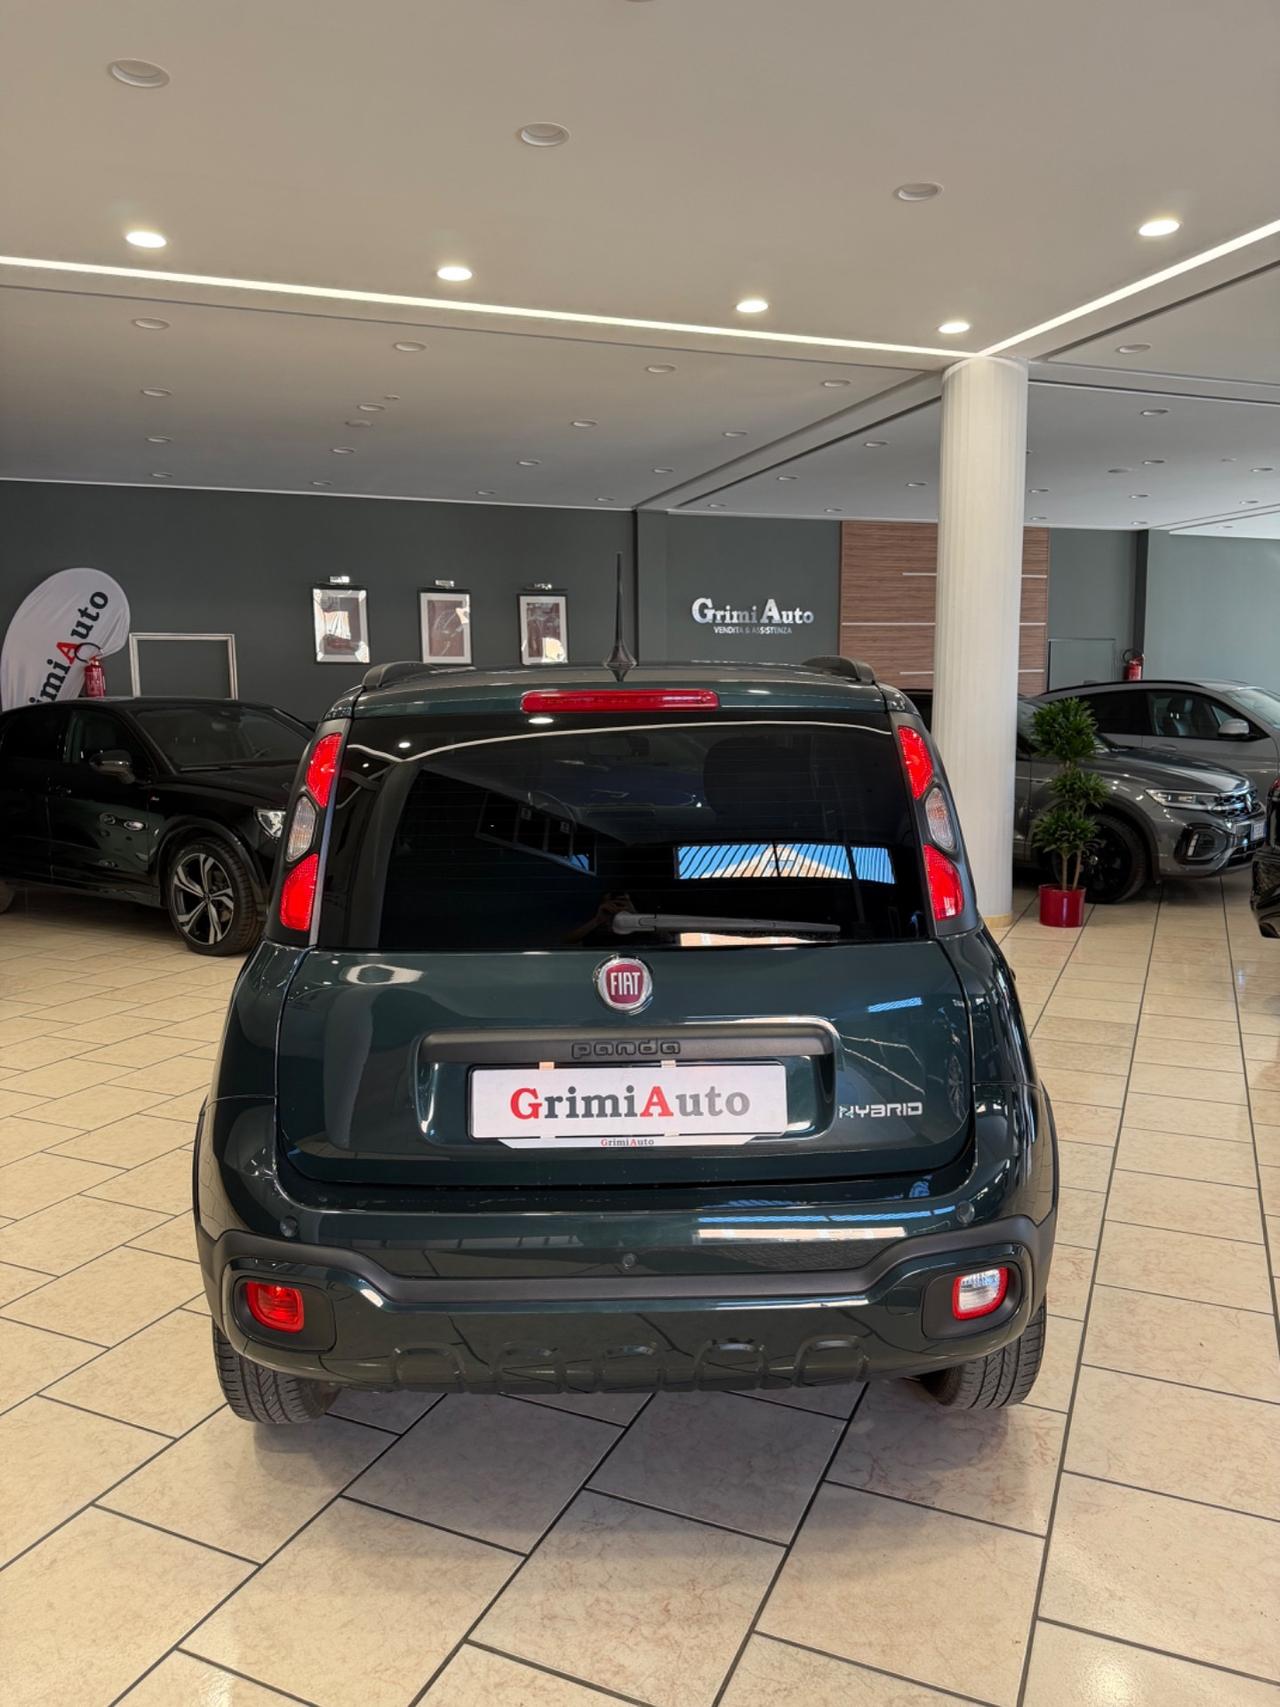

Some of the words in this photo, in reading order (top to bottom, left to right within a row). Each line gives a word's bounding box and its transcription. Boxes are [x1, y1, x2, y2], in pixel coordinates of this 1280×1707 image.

[713, 626, 744, 635] VENDITA
[752, 626, 793, 635] ASSISTENZA
[610, 972, 641, 996] FIAT
[571, 1038, 681, 1060] panda
[509, 1085, 751, 1120] GrimiAuto
[838, 1102, 923, 1119] HYBRID
[600, 1136, 655, 1147] GrimiAuto
